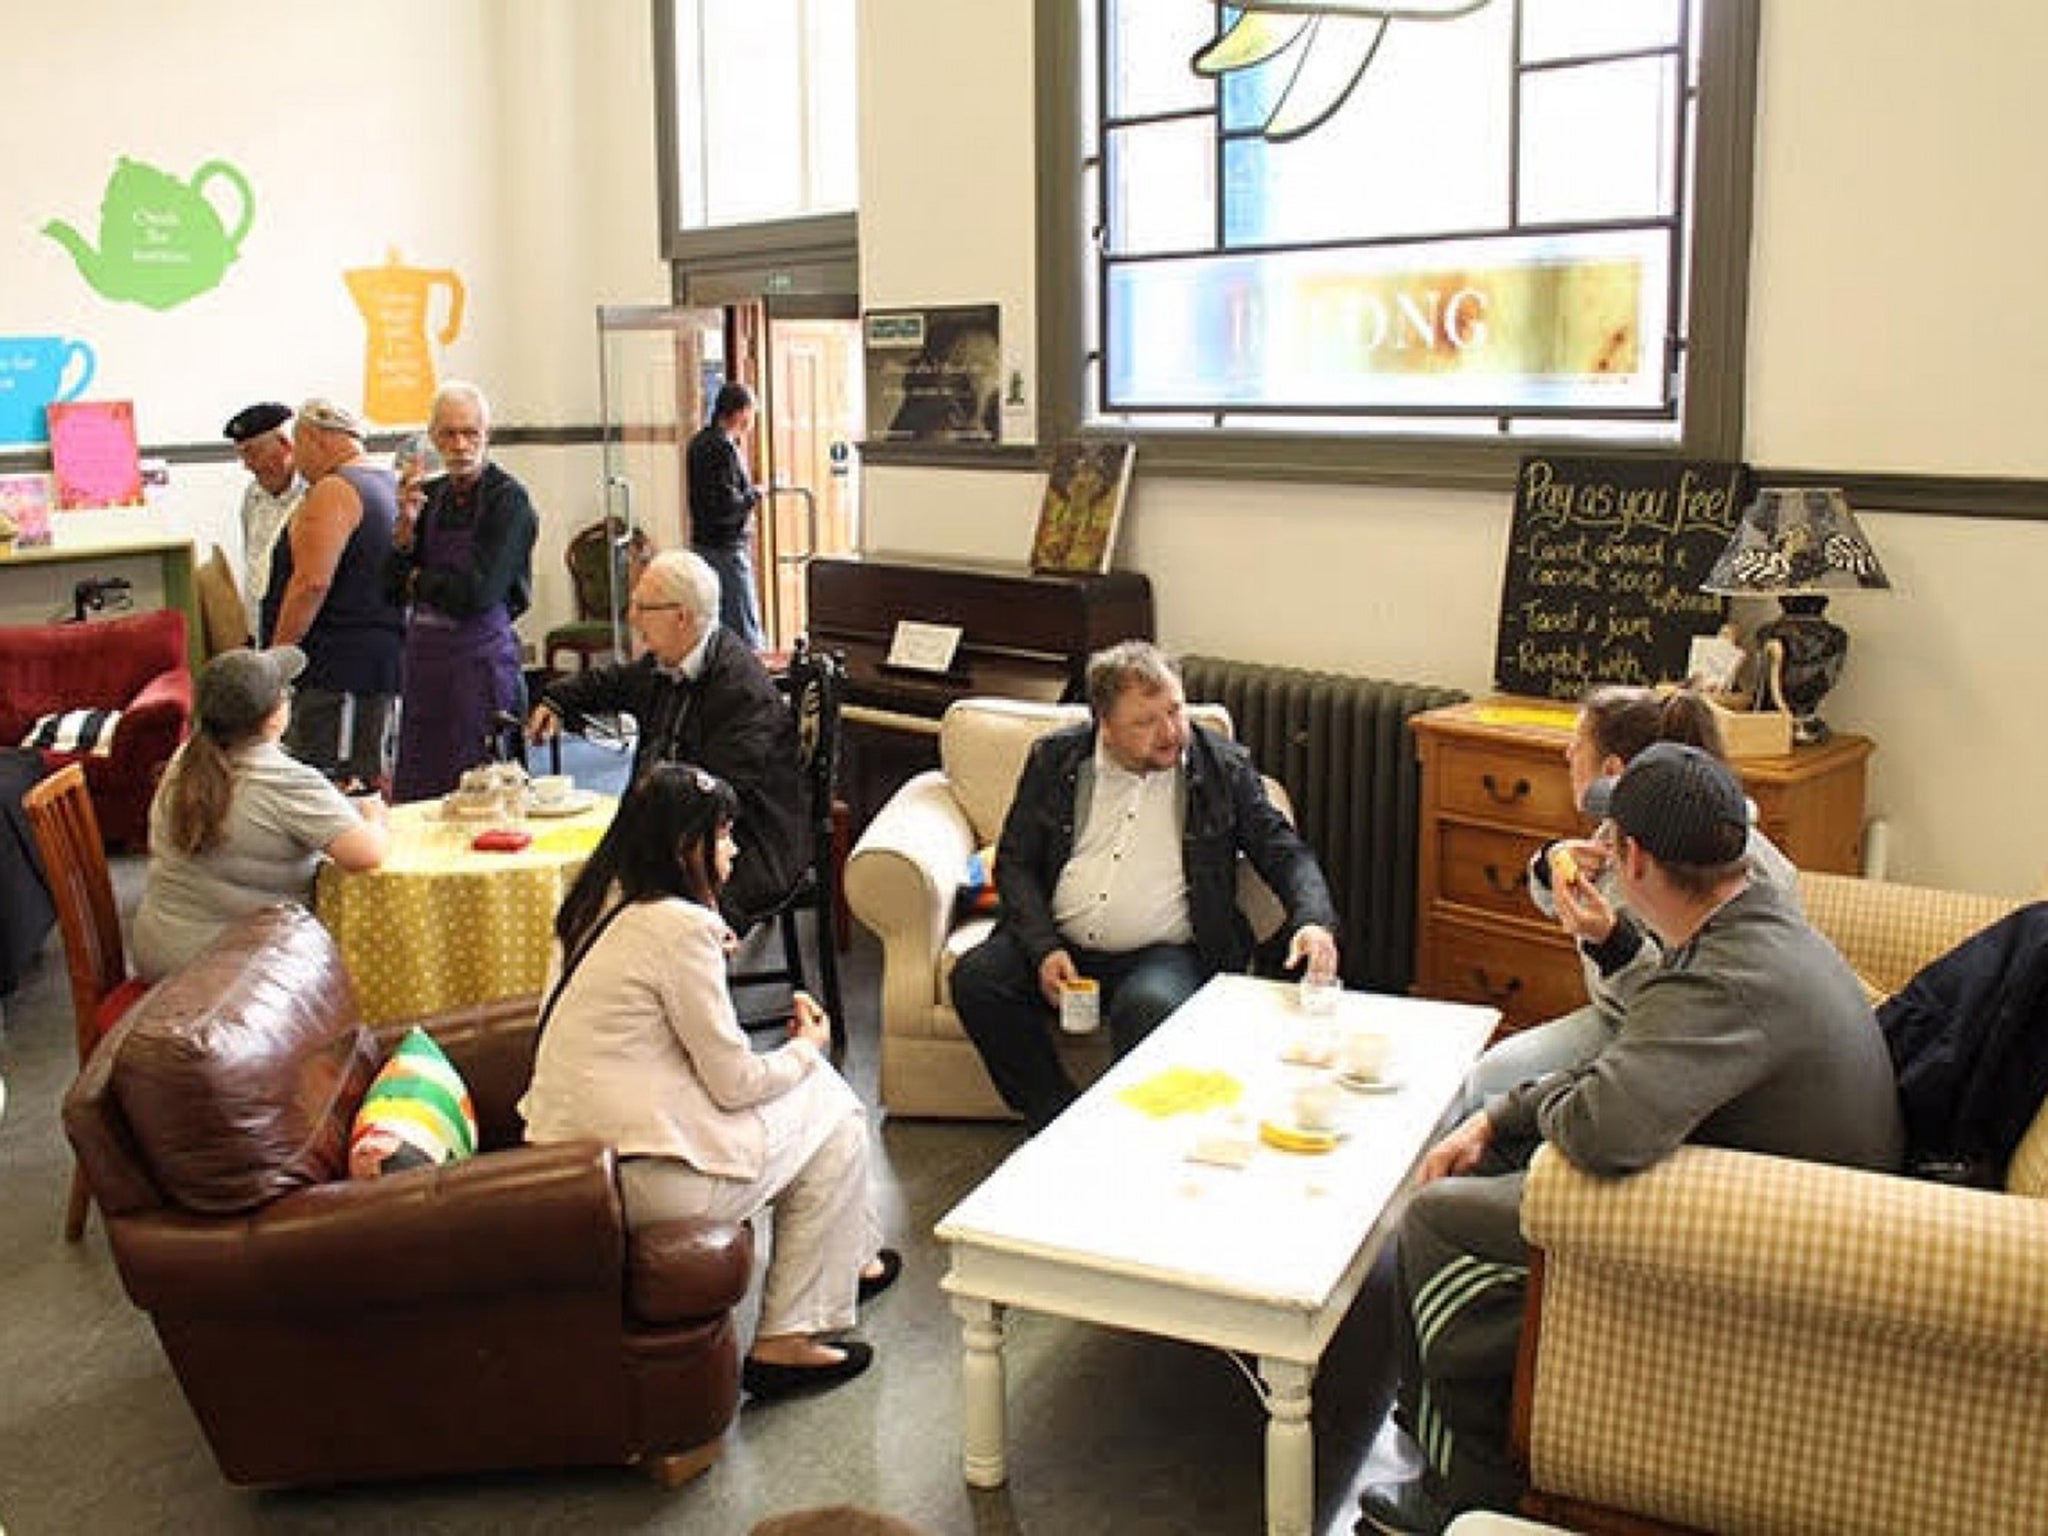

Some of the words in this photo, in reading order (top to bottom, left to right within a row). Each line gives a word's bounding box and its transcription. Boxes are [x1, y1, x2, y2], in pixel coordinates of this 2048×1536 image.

[1526, 462, 1574, 530] Pay
[1579, 483, 1614, 517] as
[1616, 487, 1669, 541] you
[1670, 468, 1738, 535] feel
